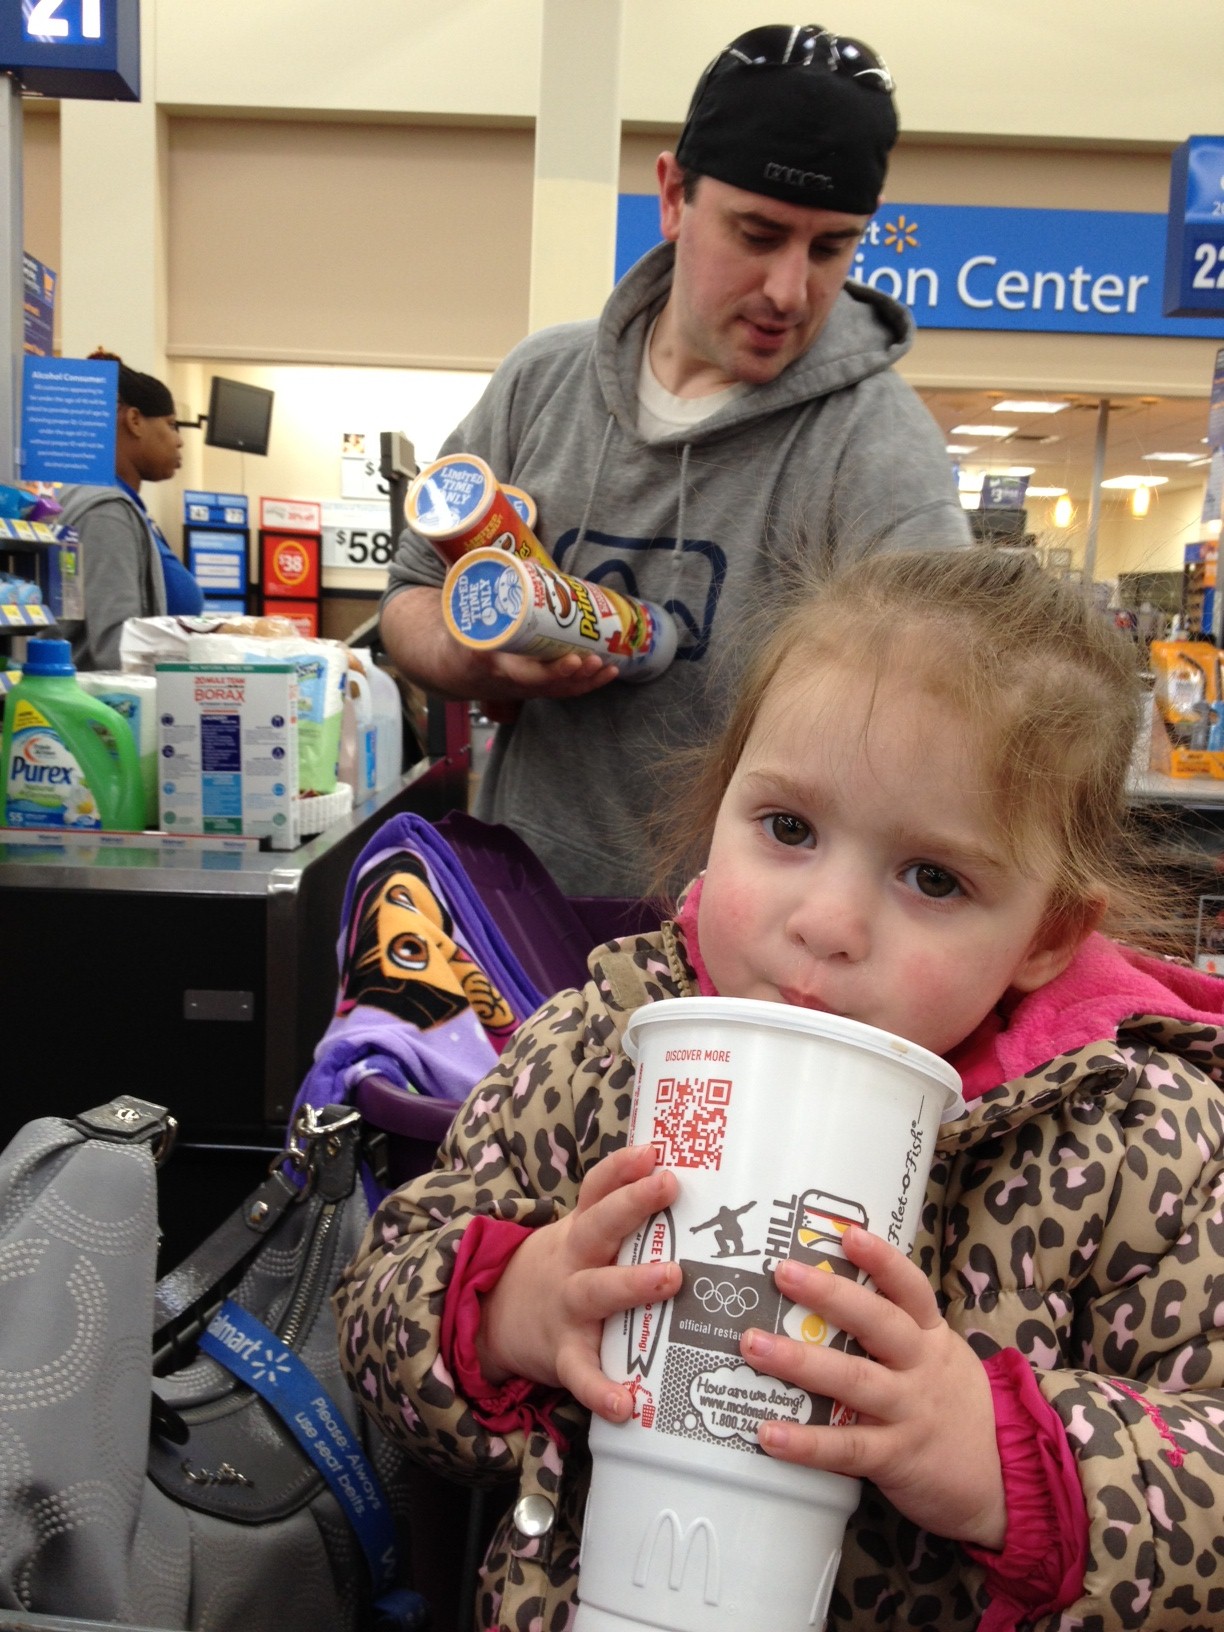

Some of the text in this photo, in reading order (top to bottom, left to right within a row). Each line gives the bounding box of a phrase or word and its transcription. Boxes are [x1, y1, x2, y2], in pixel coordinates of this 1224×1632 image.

[854, 252, 1149, 314] ion Center
[440, 467, 484, 485] LIMITED
[442, 478, 475, 495] TIME
[441, 488, 471, 506] NLY
[457, 574, 472, 632] LIMITED
[470, 582, 482, 624] TIME
[194, 688, 246, 702] BORAX
[11, 756, 73, 785] Purex
[665, 1050, 731, 1063] DISCOVER MORE
[650, 1222, 667, 1256] FREE
[207, 1311, 263, 1361] almart
[638, 1313, 653, 1353] Surfing!
[679, 1318, 744, 1342] official restau
[696, 1376, 806, 1416] How are we doing?
[710, 1410, 759, 1435] 1.800.244
[294, 1410, 319, 1439] use
[314, 1438, 345, 1472] seat
[346, 1452, 383, 1510] Always
